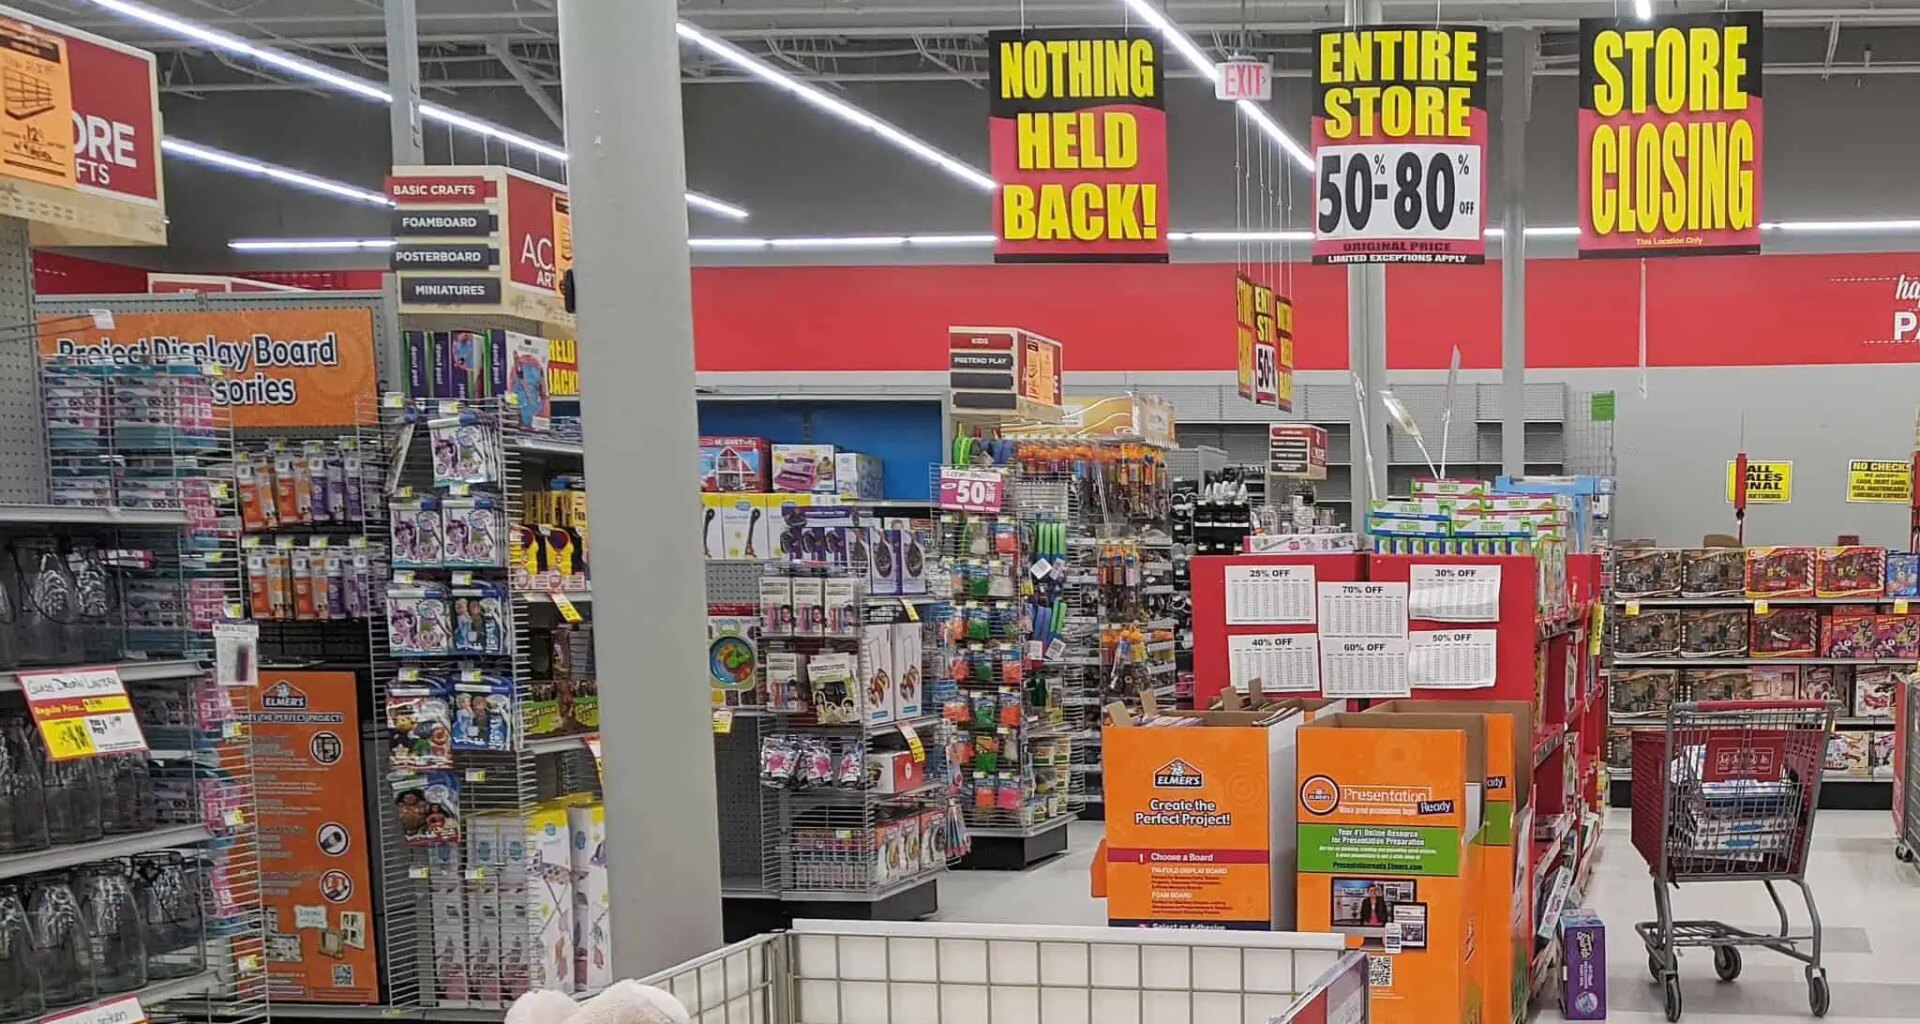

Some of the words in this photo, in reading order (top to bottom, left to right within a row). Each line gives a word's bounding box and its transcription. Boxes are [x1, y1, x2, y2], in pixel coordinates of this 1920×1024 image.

[1320, 31, 1477, 82] ENTIRE
[1000, 39, 1154, 99] NOTHING
[1593, 26, 1748, 116] STORE
[1224, 65, 1263, 96] EXIT
[1324, 86, 1471, 138] STORE
[1017, 112, 1138, 168] HELD
[75, 158, 110, 184] FTS
[1592, 119, 1753, 235] CLOSING
[393, 185, 428, 195] BASIC
[430, 185, 475, 195] CRAFTS
[1003, 183, 1157, 240] BACK!
[1459, 202, 1474, 215] OFF
[402, 217, 477, 228] FOAMBOARD
[1343, 241, 1407, 251] ORIGINAL
[1410, 242, 1453, 251] PRICE
[1653, 237, 1685, 245] Location
[1686, 236, 1703, 246] Only
[396, 251, 481, 262] POSTERBOARD
[1328, 254, 1367, 263] LIMITED
[1369, 254, 1433, 263] EXCEPTIONS
[1434, 254, 1467, 263] APPLY
[415, 285, 485, 296] MINIATURES
[153, 336, 248, 371] Display
[253, 333, 337, 366] Board
[213, 373, 295, 405] sories
[1747, 465, 1773, 473] ALL
[1853, 462, 1868, 471] NO
[1747, 474, 1783, 482] ALES
[1746, 482, 1782, 490] INAL
[1249, 570, 1269, 578] 25%
[1272, 570, 1290, 578] OFF
[1435, 569, 1455, 578] 30%
[1458, 569, 1477, 577] OFF
[1342, 586, 1363, 594] 70%
[1365, 586, 1384, 594] OFF
[1252, 639, 1272, 647] 40%
[1274, 638, 1293, 646] OFF
[1432, 634, 1452, 642] 50%
[1344, 643, 1365, 651] 60%
[1366, 643, 1386, 651] OFF
[1156, 776, 1200, 785] ELMER'S
[1343, 788, 1426, 803] Presentation
[1150, 799, 1193, 811] Create
[1194, 799, 1215, 811] the
[1420, 801, 1452, 814] Ready
[1135, 812, 1180, 825] Perfect
[1181, 812, 1230, 826] Project!
[1364, 829, 1386, 837] Online
[1387, 830, 1418, 838] Resource
[1342, 837, 1385, 845] Presentation
[1386, 837, 1425, 846] Preparation
[1150, 852, 1182, 861] Choose
[1189, 853, 1214, 861] Board
